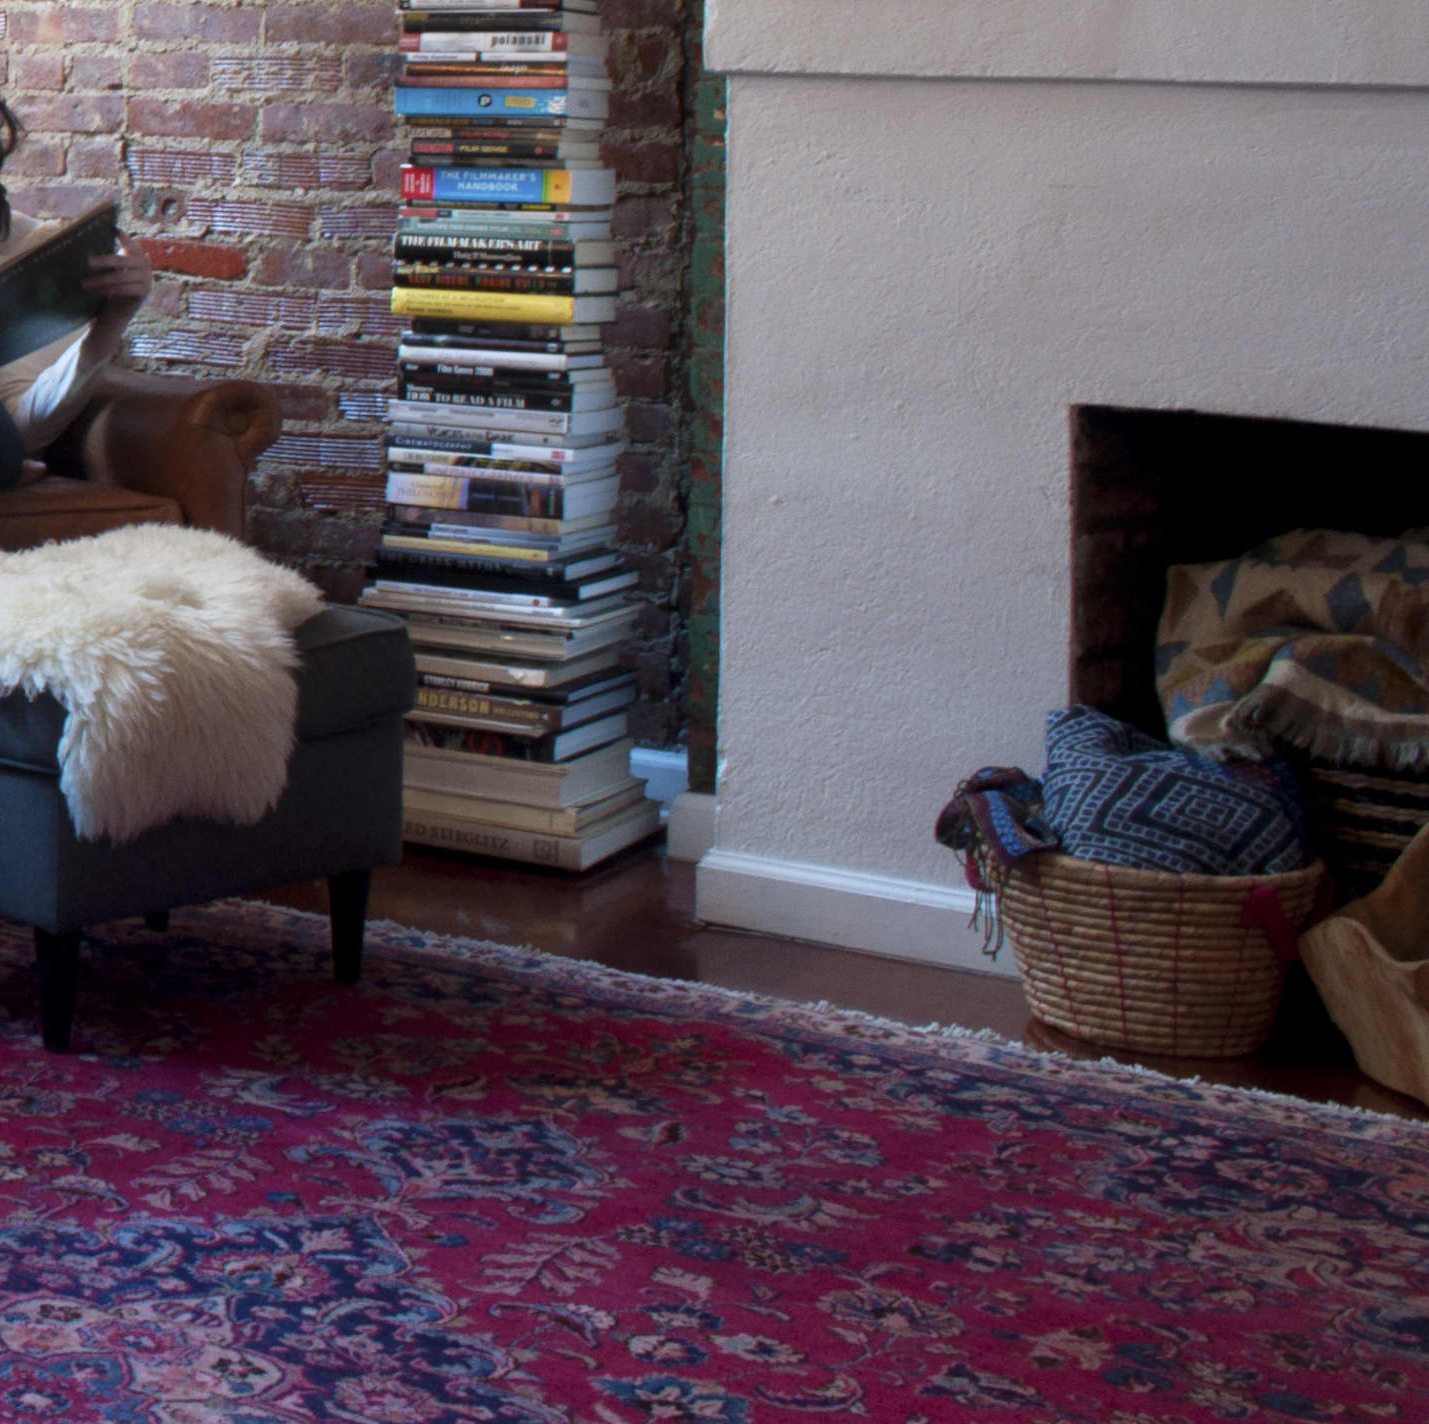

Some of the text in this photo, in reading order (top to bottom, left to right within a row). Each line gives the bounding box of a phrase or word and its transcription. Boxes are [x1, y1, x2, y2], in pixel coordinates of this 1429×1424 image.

[491, 34, 546, 49] polanski
[442, 171, 460, 179] THE
[457, 182, 519, 192] HANDBOOK
[400, 235, 426, 246] THE
[437, 363, 451, 373] Film
[406, 391, 431, 401] HOW
[435, 393, 450, 402] TO
[452, 394, 485, 405] READ
[496, 396, 527, 408] FILM
